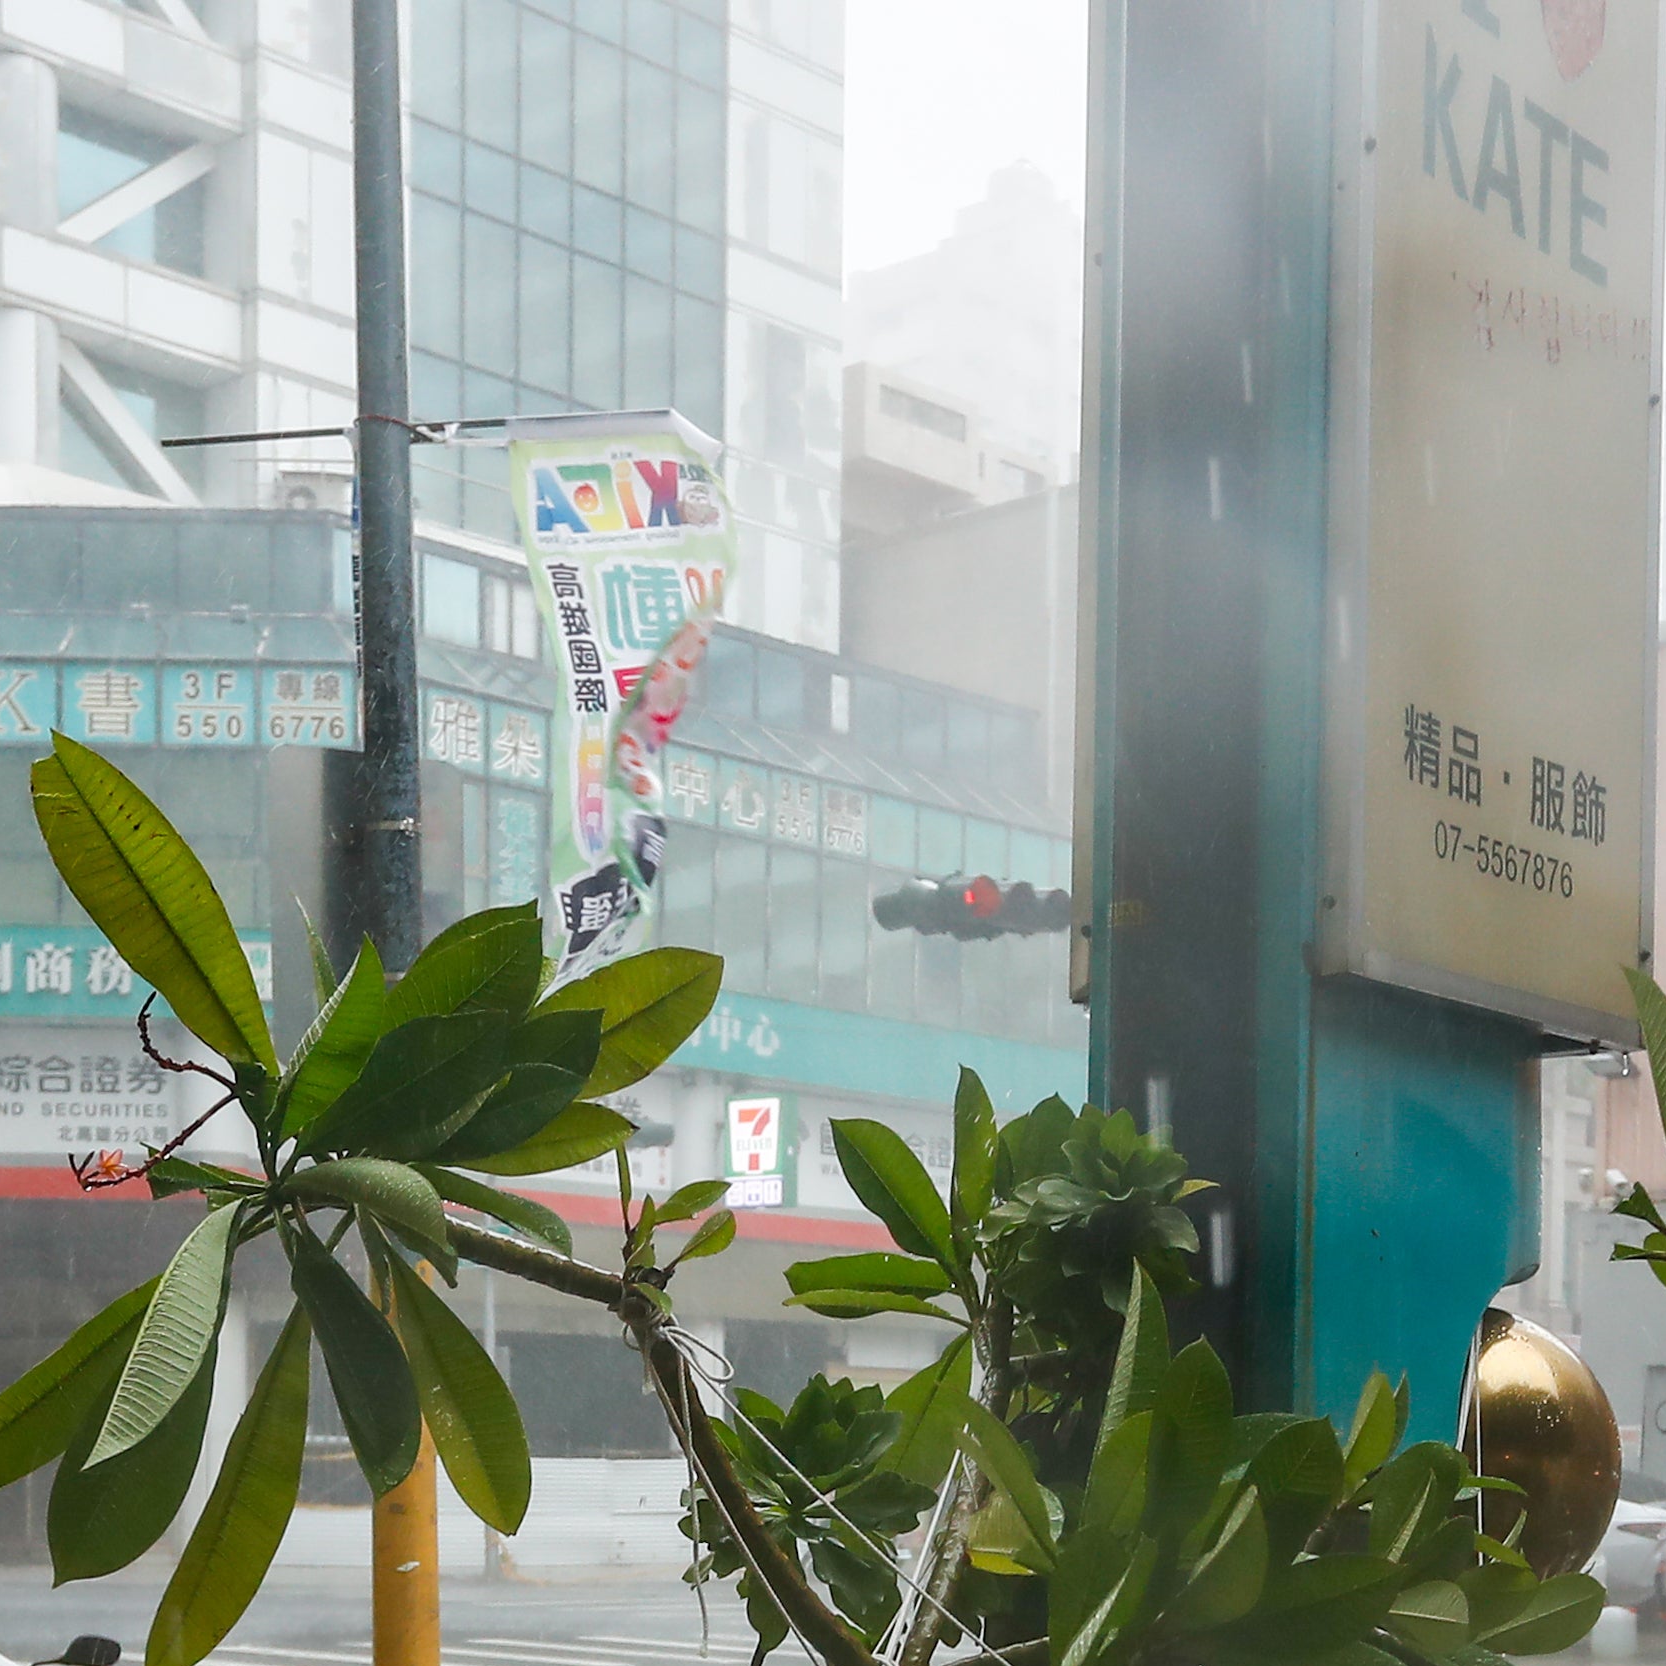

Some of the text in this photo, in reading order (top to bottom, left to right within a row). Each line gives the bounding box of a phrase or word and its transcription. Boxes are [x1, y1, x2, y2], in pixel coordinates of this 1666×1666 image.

[1422, 21, 1610, 287] KATE
[177, 714, 242, 740] 550
[269, 715, 345, 741] 6776
[431, 694, 542, 780] 雅朵
[667, 757, 765, 830] 中心
[1434, 820, 1574, 899] 07-5567876
[689, 1005, 781, 1057] 中心
[40, 1101, 170, 1119] SECURITIES
[737, 1107, 771, 1171] 7
